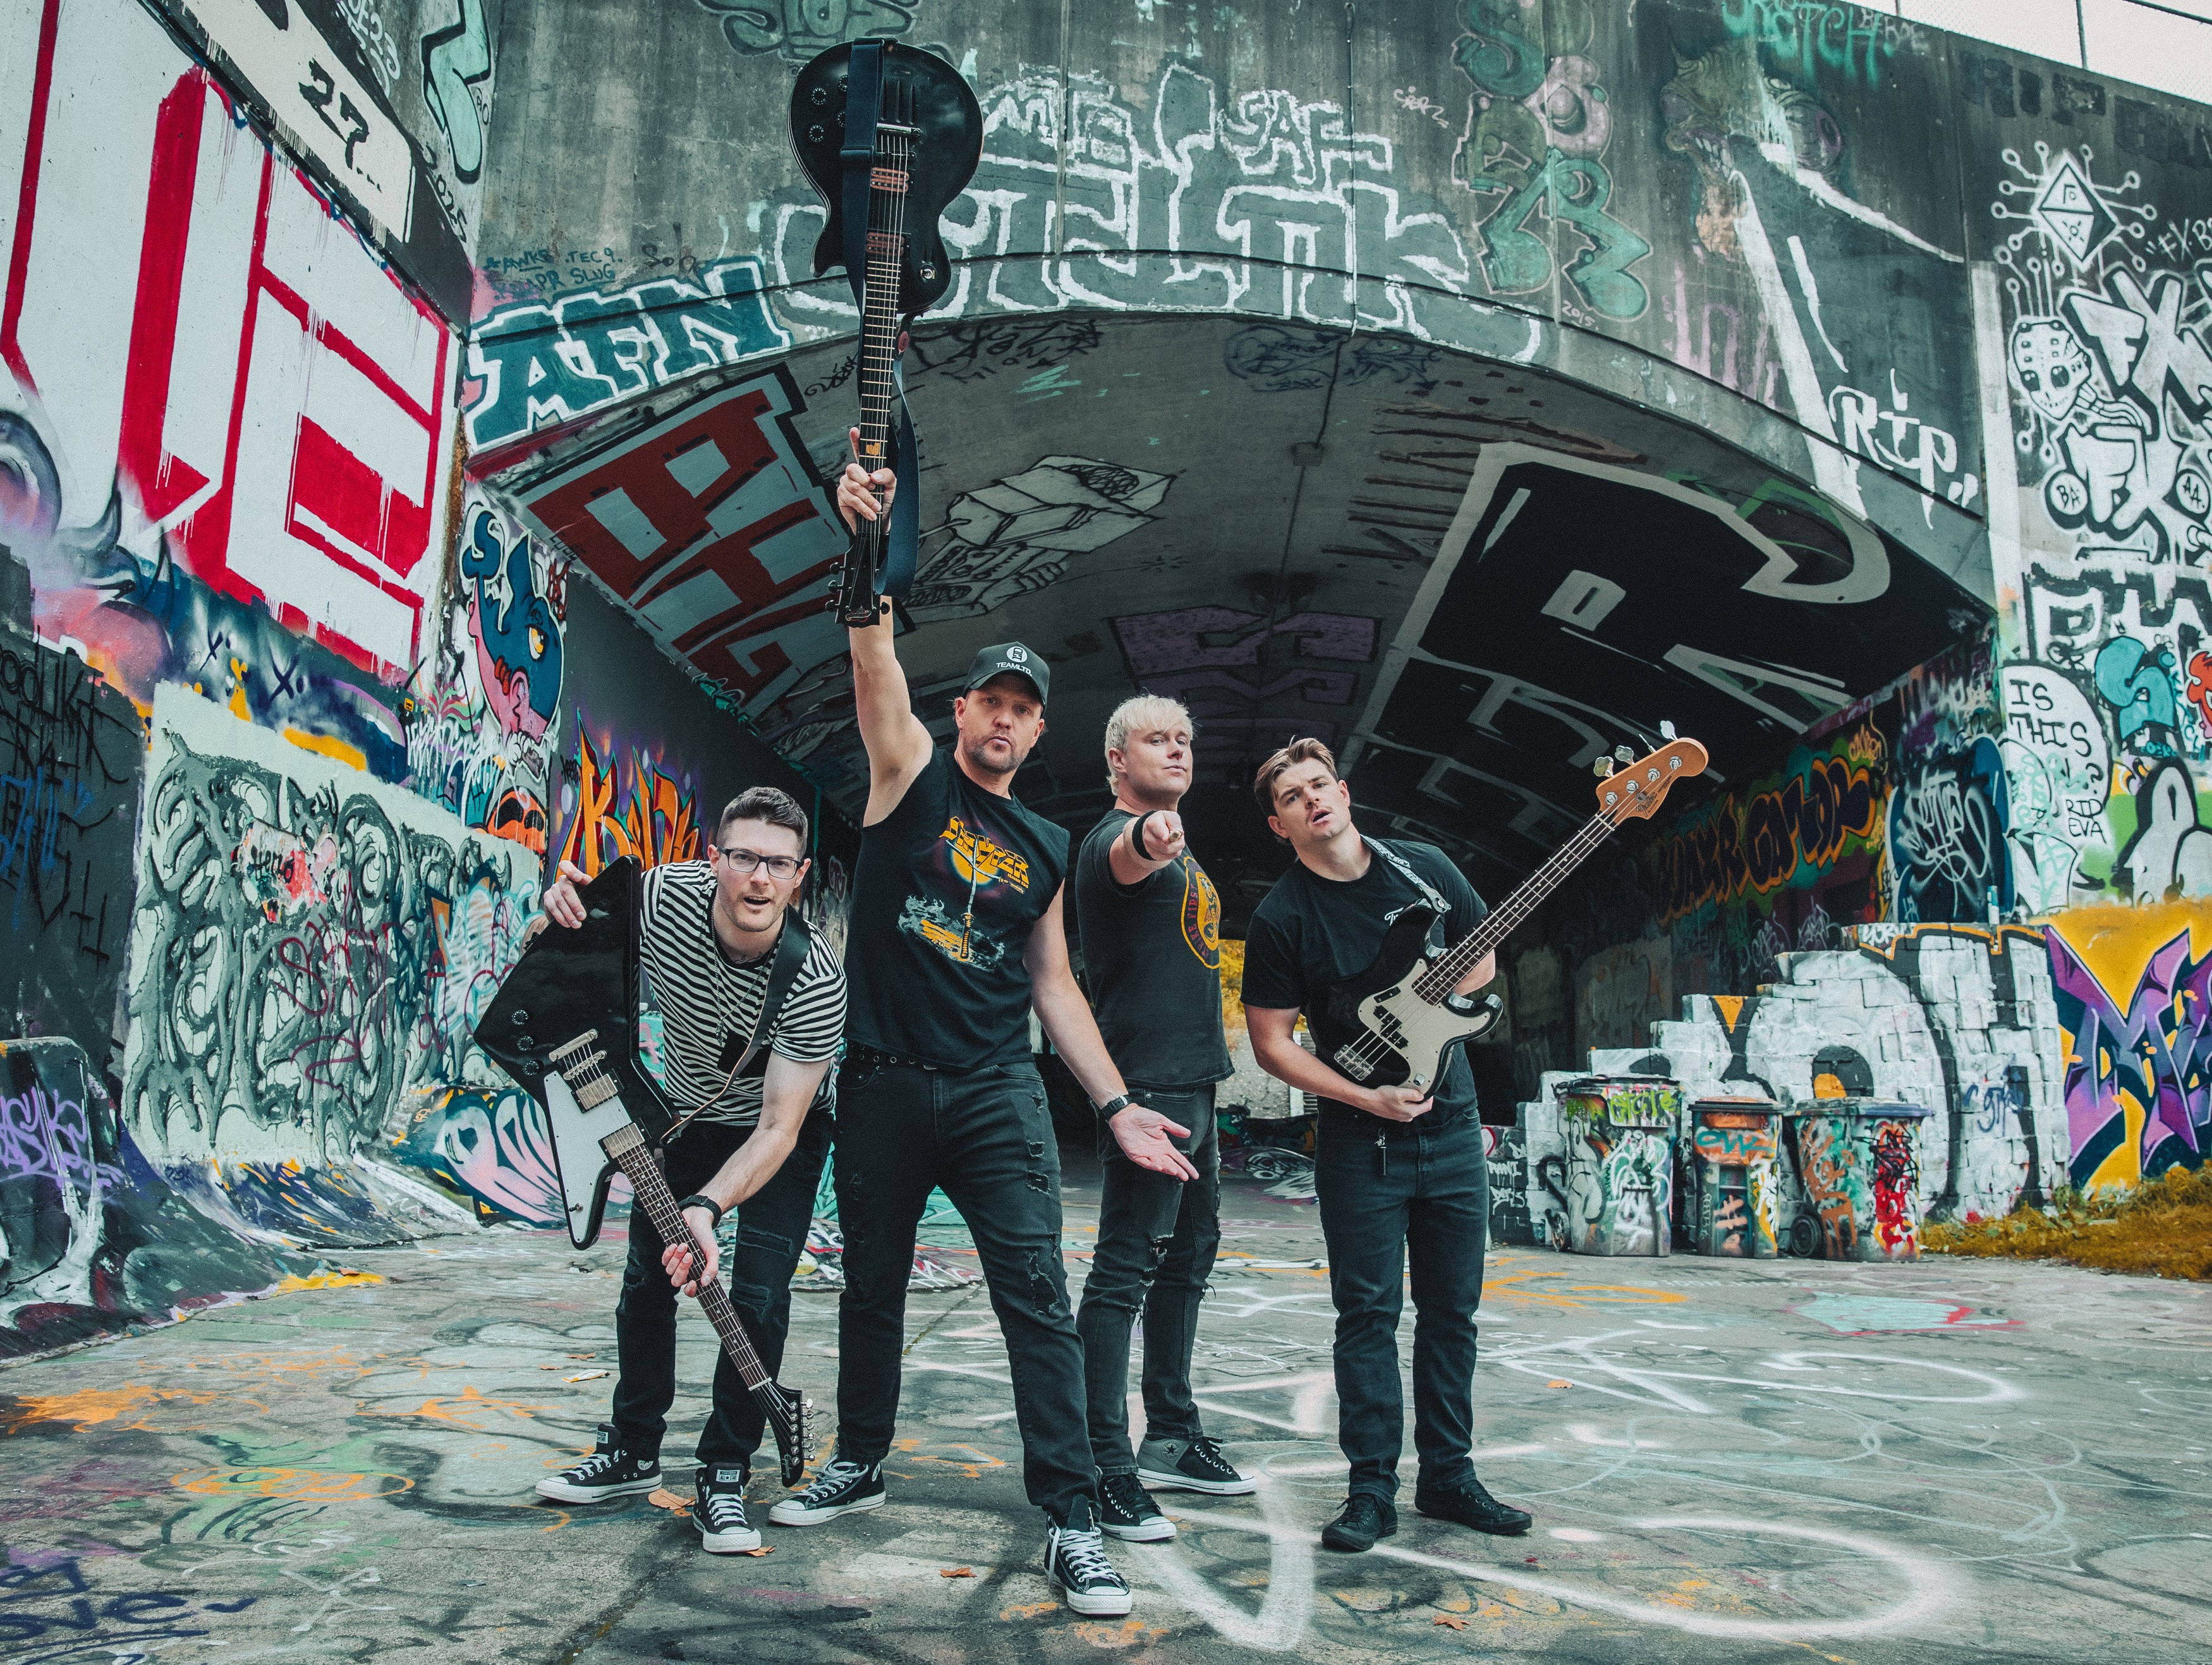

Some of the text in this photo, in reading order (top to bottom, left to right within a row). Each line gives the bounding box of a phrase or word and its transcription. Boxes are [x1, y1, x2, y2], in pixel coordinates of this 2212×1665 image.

[570, 263, 616, 284] SLUG
[995, 661, 1033, 677] TEAMLTD.
[2009, 678, 2054, 711] IS
[2008, 712, 2092, 757] THIS
